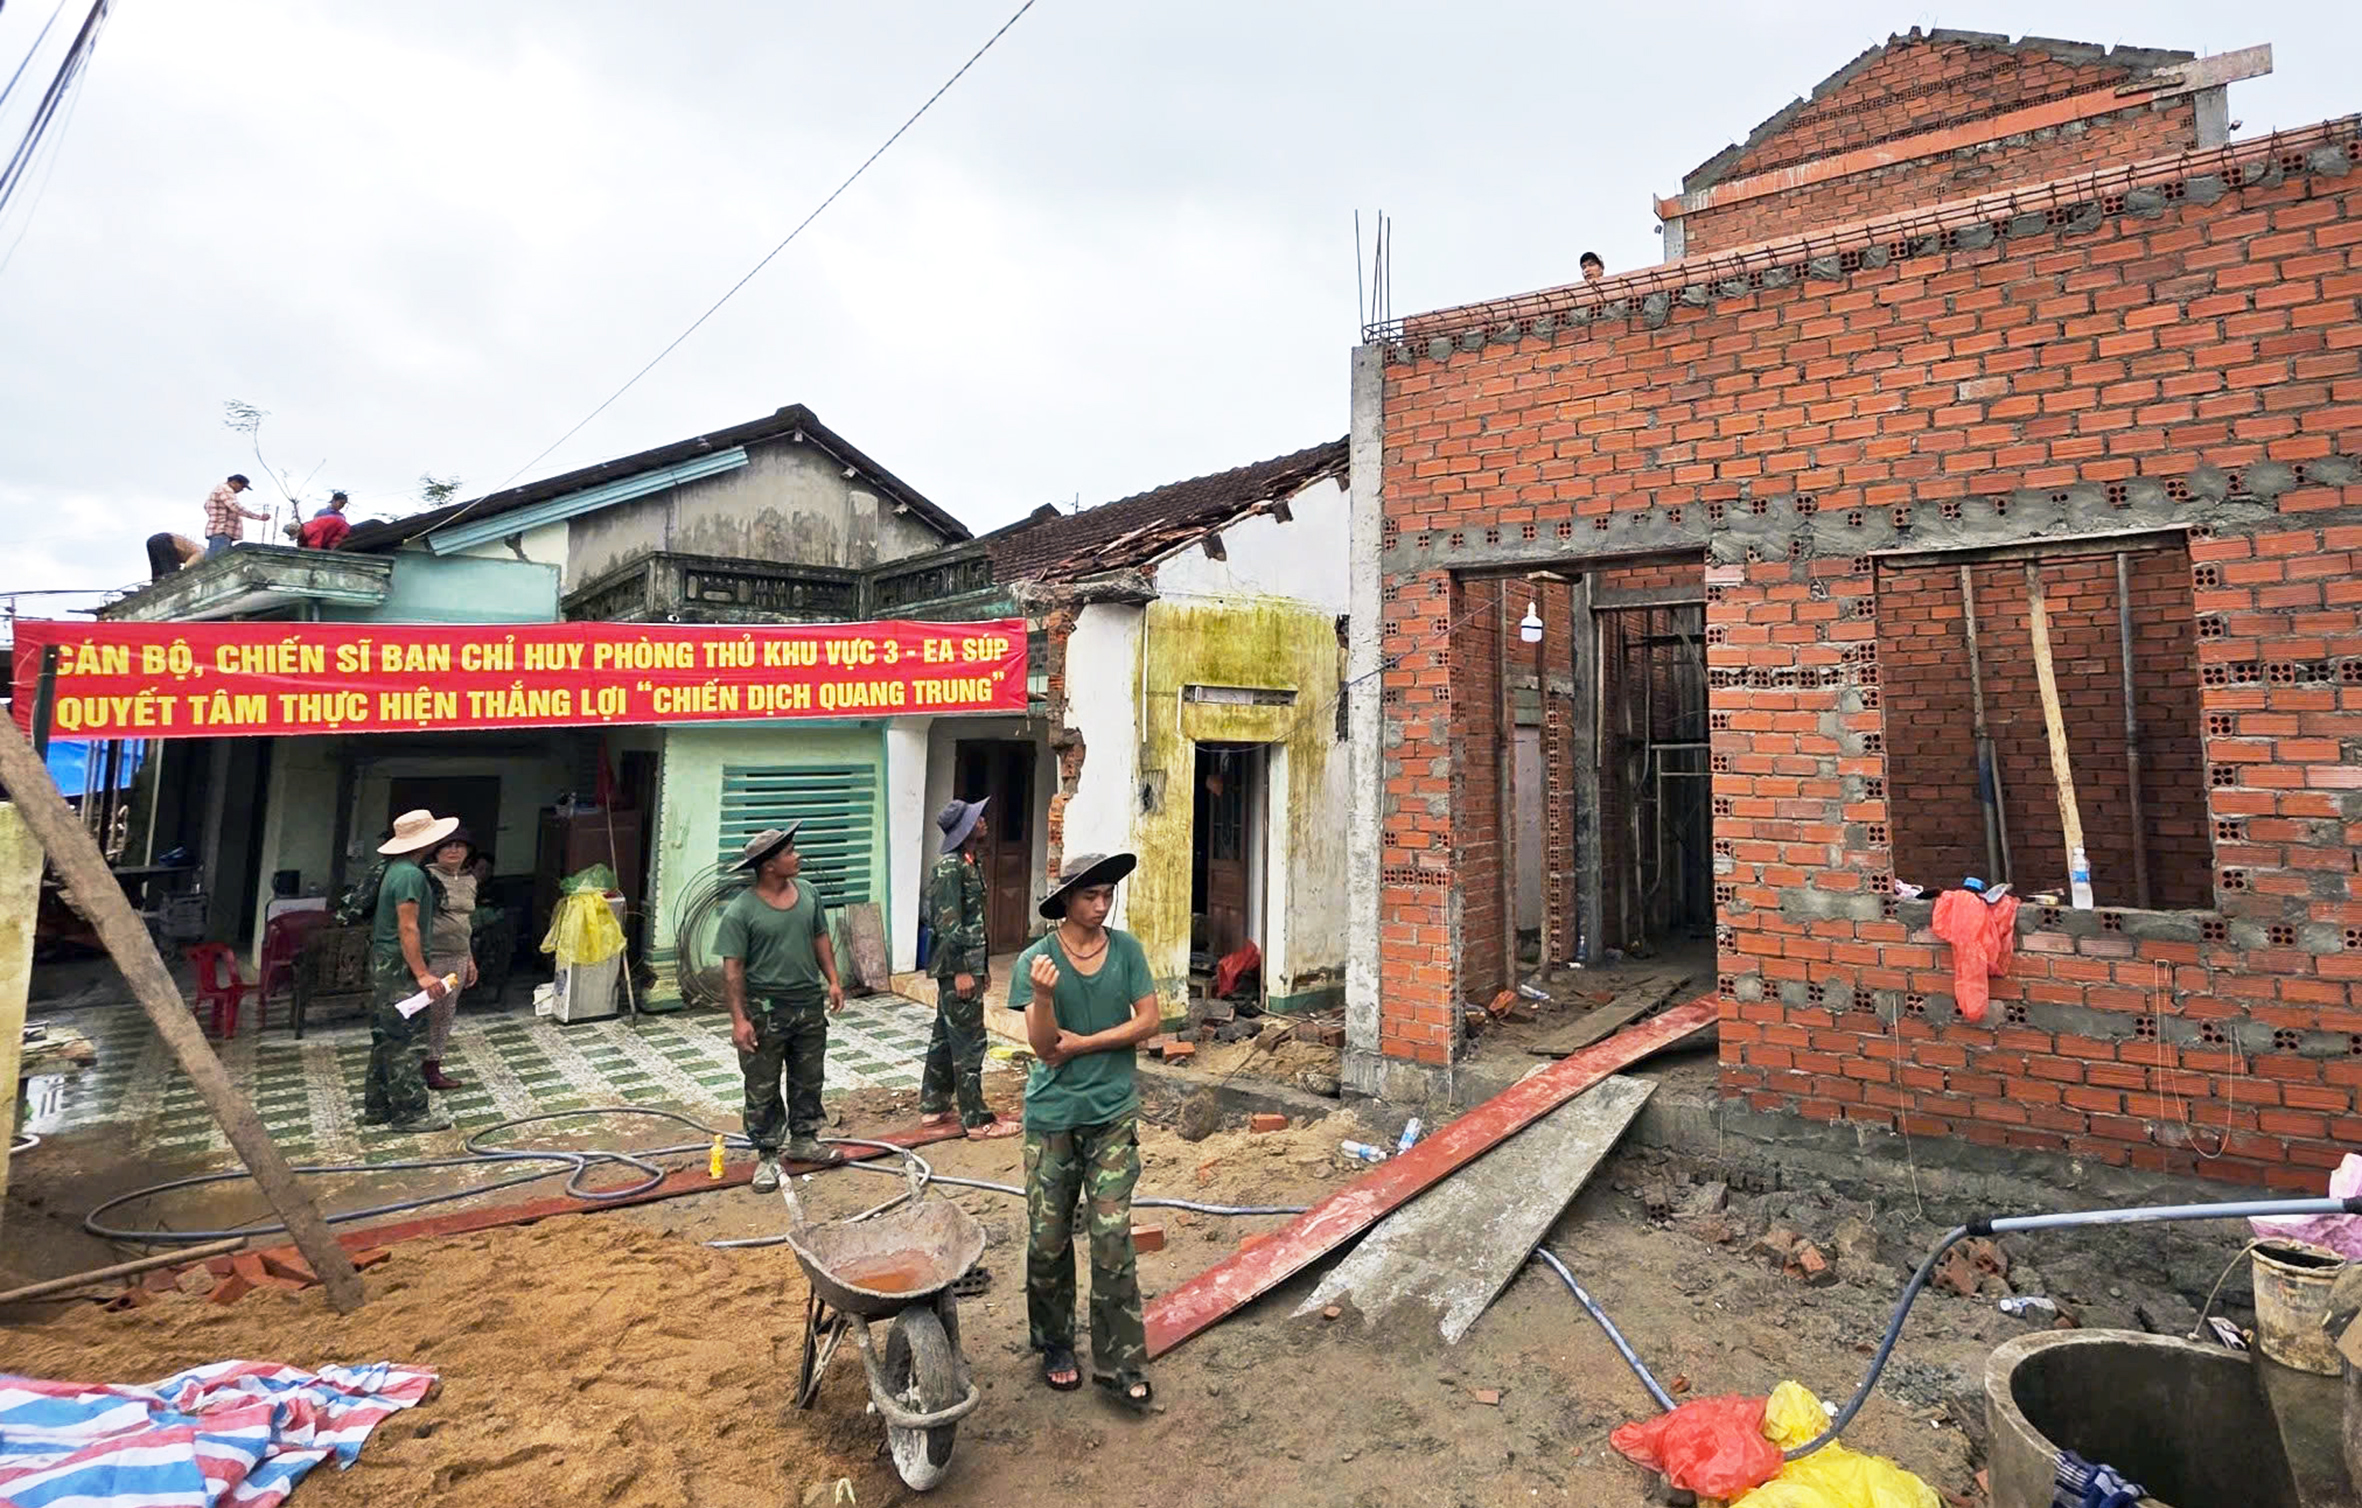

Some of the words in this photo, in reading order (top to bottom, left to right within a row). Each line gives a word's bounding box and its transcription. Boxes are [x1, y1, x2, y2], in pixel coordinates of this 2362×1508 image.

[141, 638, 204, 681] BỘ,
[215, 634, 325, 674] CHIẾN
[335, 638, 373, 673] SĨ
[381, 643, 451, 673] BAN
[460, 634, 515, 672] CHỈ
[523, 642, 585, 671] HUY
[593, 635, 695, 670] PHÒNG
[702, 633, 756, 668] THỦ
[763, 640, 818, 667] KHU
[824, 637, 877, 671] VỰC
[883, 638, 898, 664] 3
[923, 638, 955, 664] EA
[961, 633, 1009, 663] SÚP
[56, 686, 178, 731] QUYẾT
[187, 688, 268, 725] TÂM
[279, 690, 369, 729] THỰC
[379, 685, 458, 727] HIỆN
[466, 680, 571, 719] THẮNG
[580, 685, 627, 720] LỢI
[747, 683, 811, 716] DỊCH
[818, 680, 905, 711] QUANG
